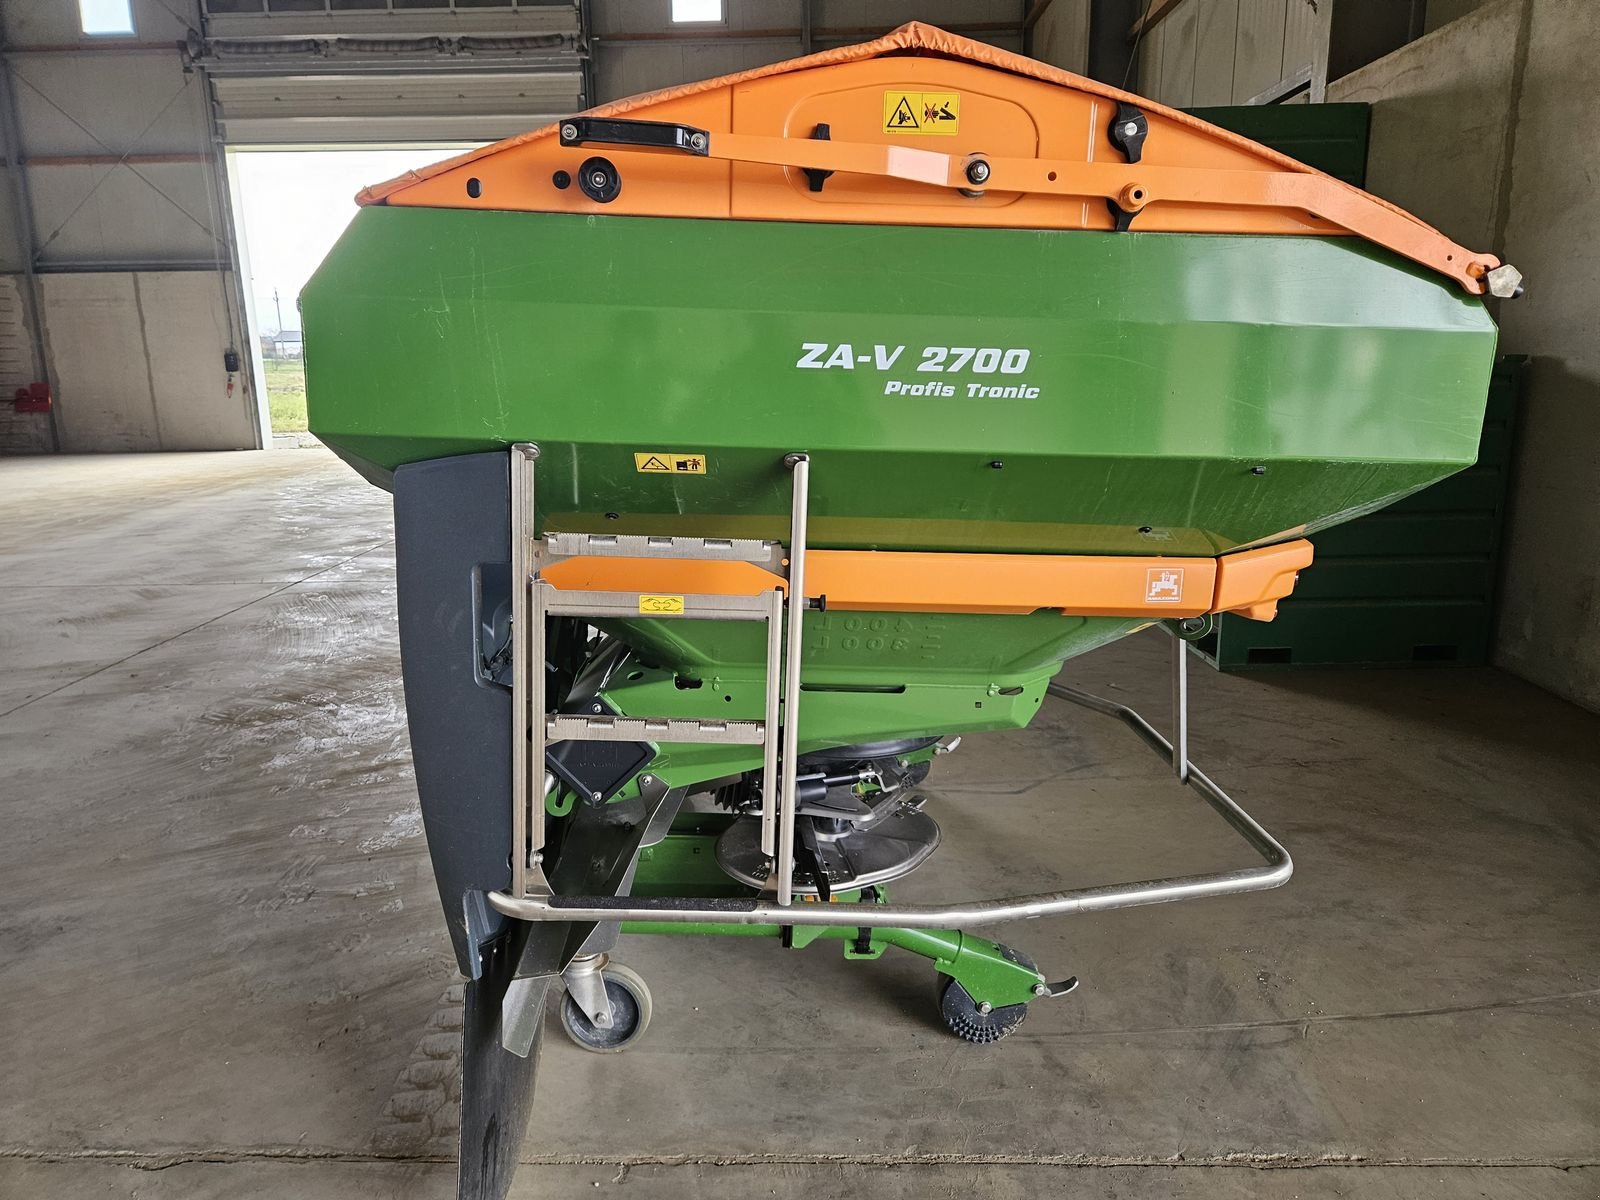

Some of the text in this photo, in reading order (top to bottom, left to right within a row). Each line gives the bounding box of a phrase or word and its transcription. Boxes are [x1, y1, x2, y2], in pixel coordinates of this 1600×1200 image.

[796, 343, 1030, 374] ZA-V 2700
[884, 381, 1040, 399] Profis Tronic
